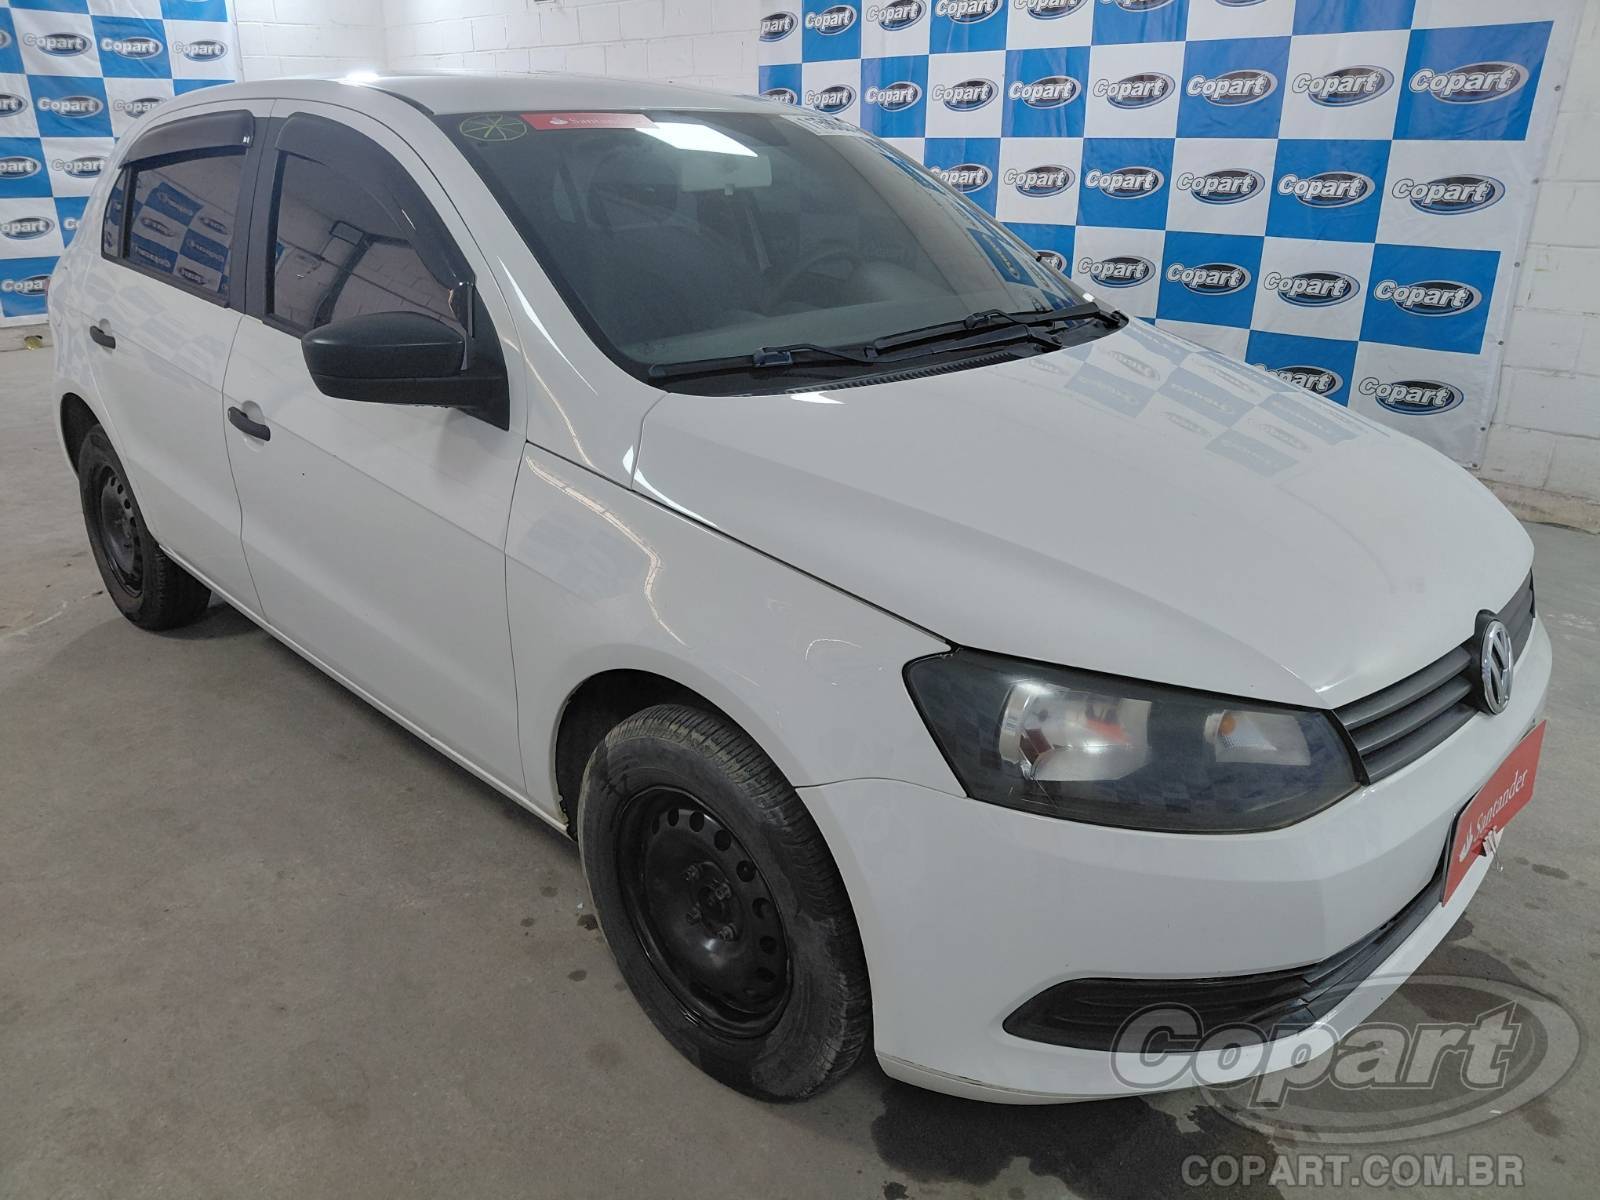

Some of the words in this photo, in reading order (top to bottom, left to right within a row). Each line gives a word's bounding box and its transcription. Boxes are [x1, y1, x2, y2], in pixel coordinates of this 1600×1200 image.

[805, 7, 852, 31] Copart
[867, 0, 920, 25] Copart
[935, 0, 992, 20] Copart
[760, 16, 793, 33] part
[23, 33, 84, 51] Copart
[101, 37, 157, 54] Copart
[174, 42, 223, 56] Copart
[932, 81, 989, 106] Copart
[1008, 79, 1072, 104] Copart
[1093, 76, 1166, 102] Copart
[1186, 73, 1267, 98] Copart
[1292, 70, 1381, 100] Copart
[1408, 65, 1515, 97] Copart
[37, 97, 96, 114] Copart
[805, 88, 850, 109] Copart
[865, 83, 914, 107] Copart
[0, 159, 34, 175] part
[930, 166, 984, 187] opart
[1003, 167, 1066, 194] Copart
[1085, 168, 1154, 196] Copart
[1177, 171, 1254, 197] Copart
[1277, 173, 1368, 203] Copart
[1391, 178, 1490, 206] Copart
[0, 220, 46, 236] opart
[1078, 256, 1146, 282] Copart
[1165, 262, 1244, 288] Copart
[2, 278, 44, 293] Copa
[1263, 271, 1347, 300] Copart
[1374, 280, 1469, 312] Copart
[1255, 364, 1332, 391] part
[1358, 376, 1451, 408] Copart
[1474, 769, 1528, 842] Santander
